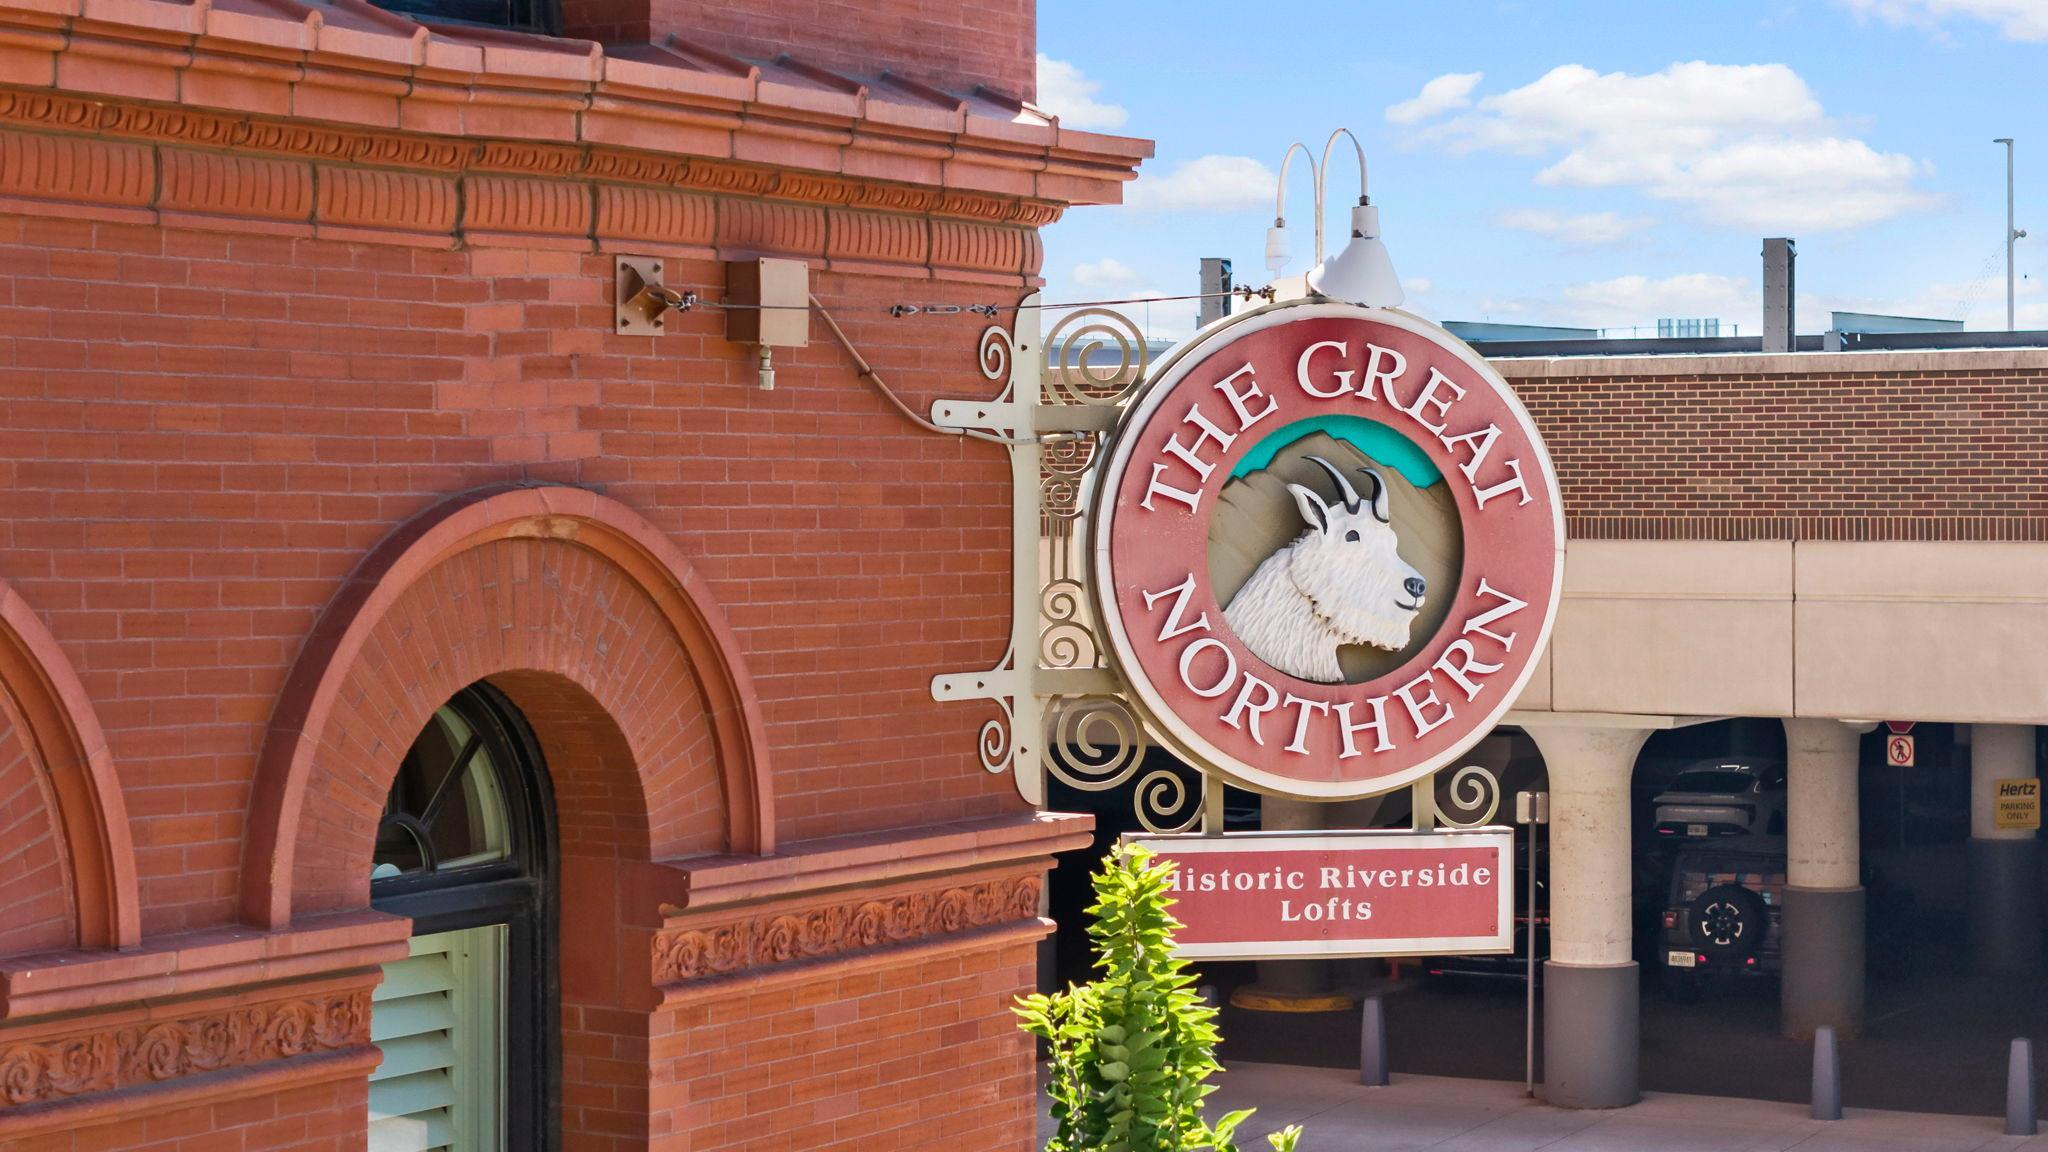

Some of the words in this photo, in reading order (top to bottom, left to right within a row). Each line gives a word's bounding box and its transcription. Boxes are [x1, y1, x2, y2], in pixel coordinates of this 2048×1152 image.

[1140, 361, 1279, 514] THE
[1297, 340, 1534, 511] GREAT
[1142, 573, 1529, 759] NORTHERN
[2000, 782, 2037, 797] Hertz
[2000, 802, 2036, 811] PARKING
[2006, 811, 2029, 820] ONLY
[1320, 862, 1491, 889] Riverside
[1281, 896, 1372, 922] Lofts
